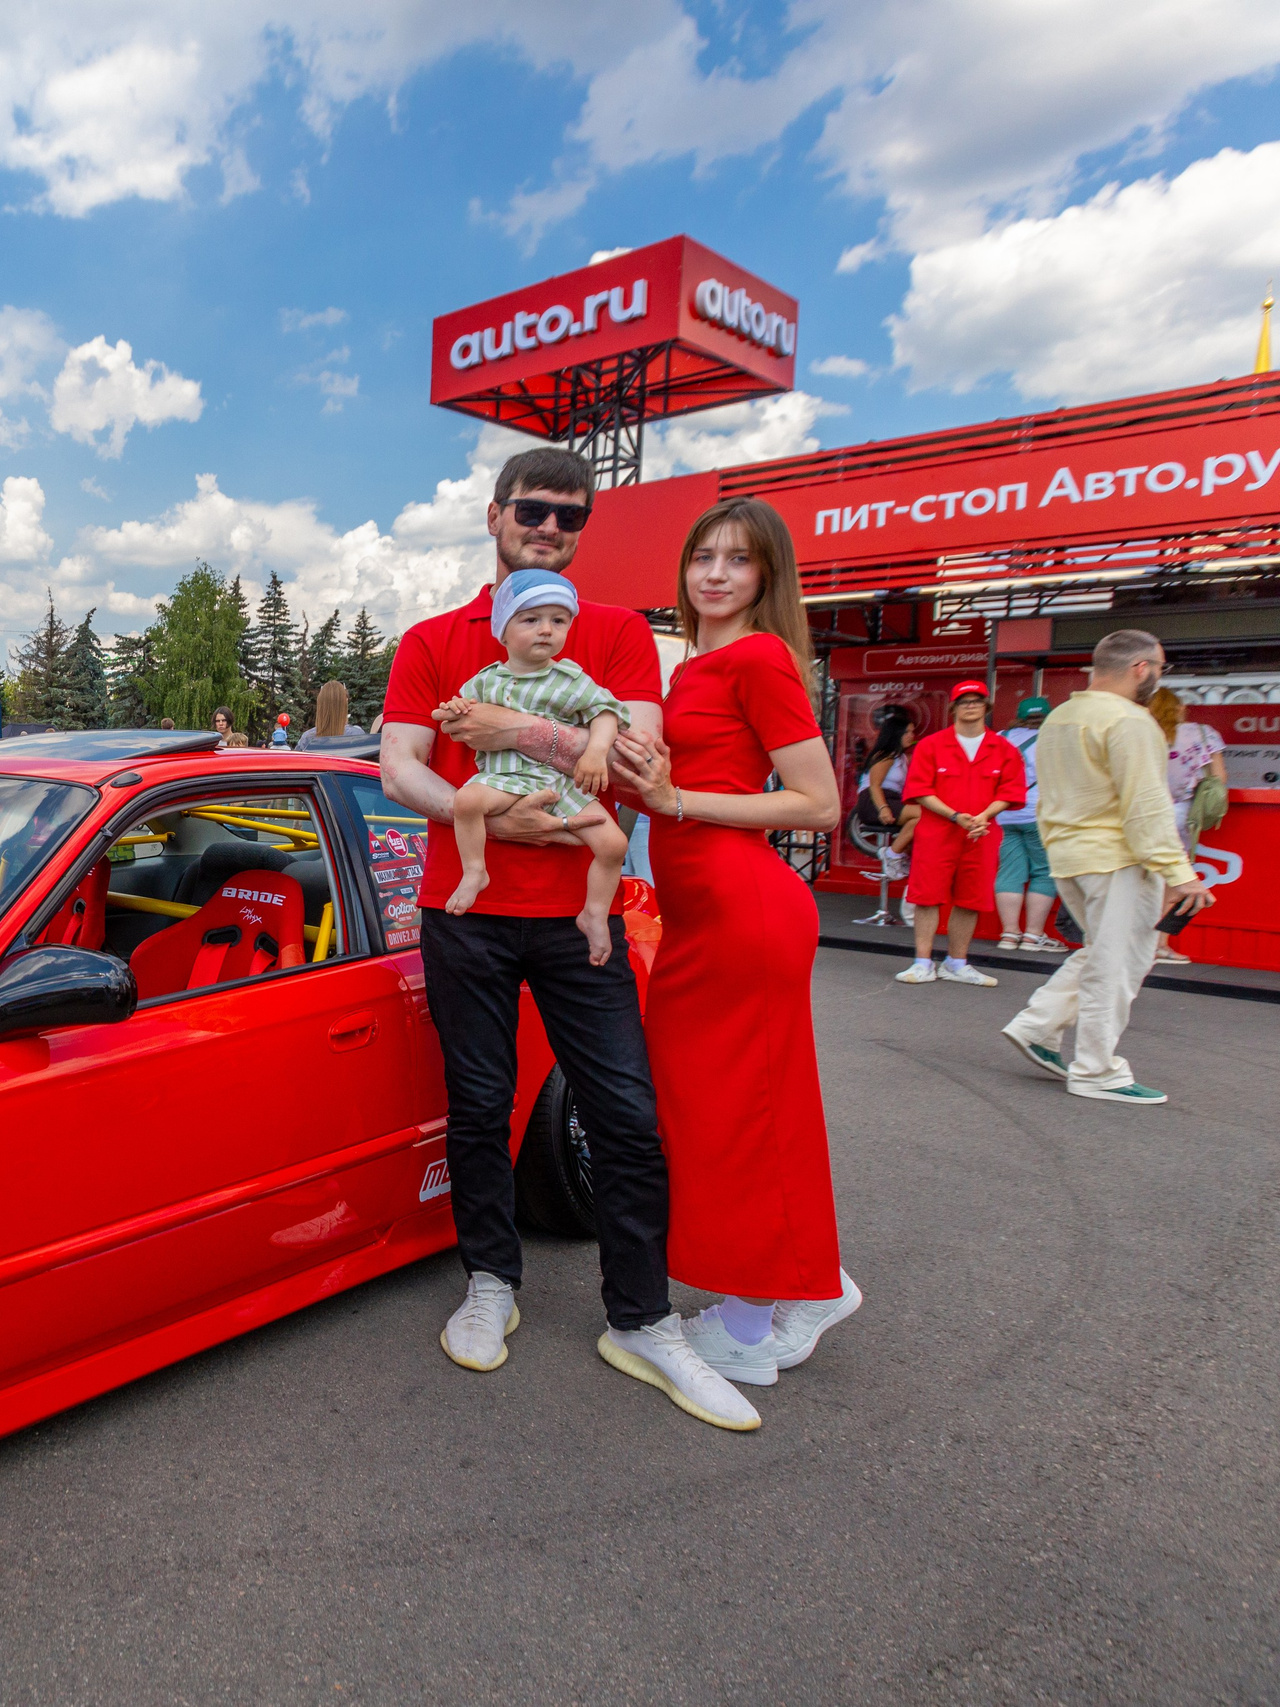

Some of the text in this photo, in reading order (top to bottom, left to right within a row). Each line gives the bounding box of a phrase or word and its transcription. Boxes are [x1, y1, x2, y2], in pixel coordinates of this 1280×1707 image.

[450, 278, 648, 370] auto.ru
[695, 278, 795, 356] auto.ru
[814, 448, 1280, 535] пит-стоп Авто.ру
[869, 682, 924, 692] auto.ru
[222, 887, 286, 906] BRIDE
[388, 902, 417, 919] Option
[388, 928, 420, 945] DRIVE2.RU
